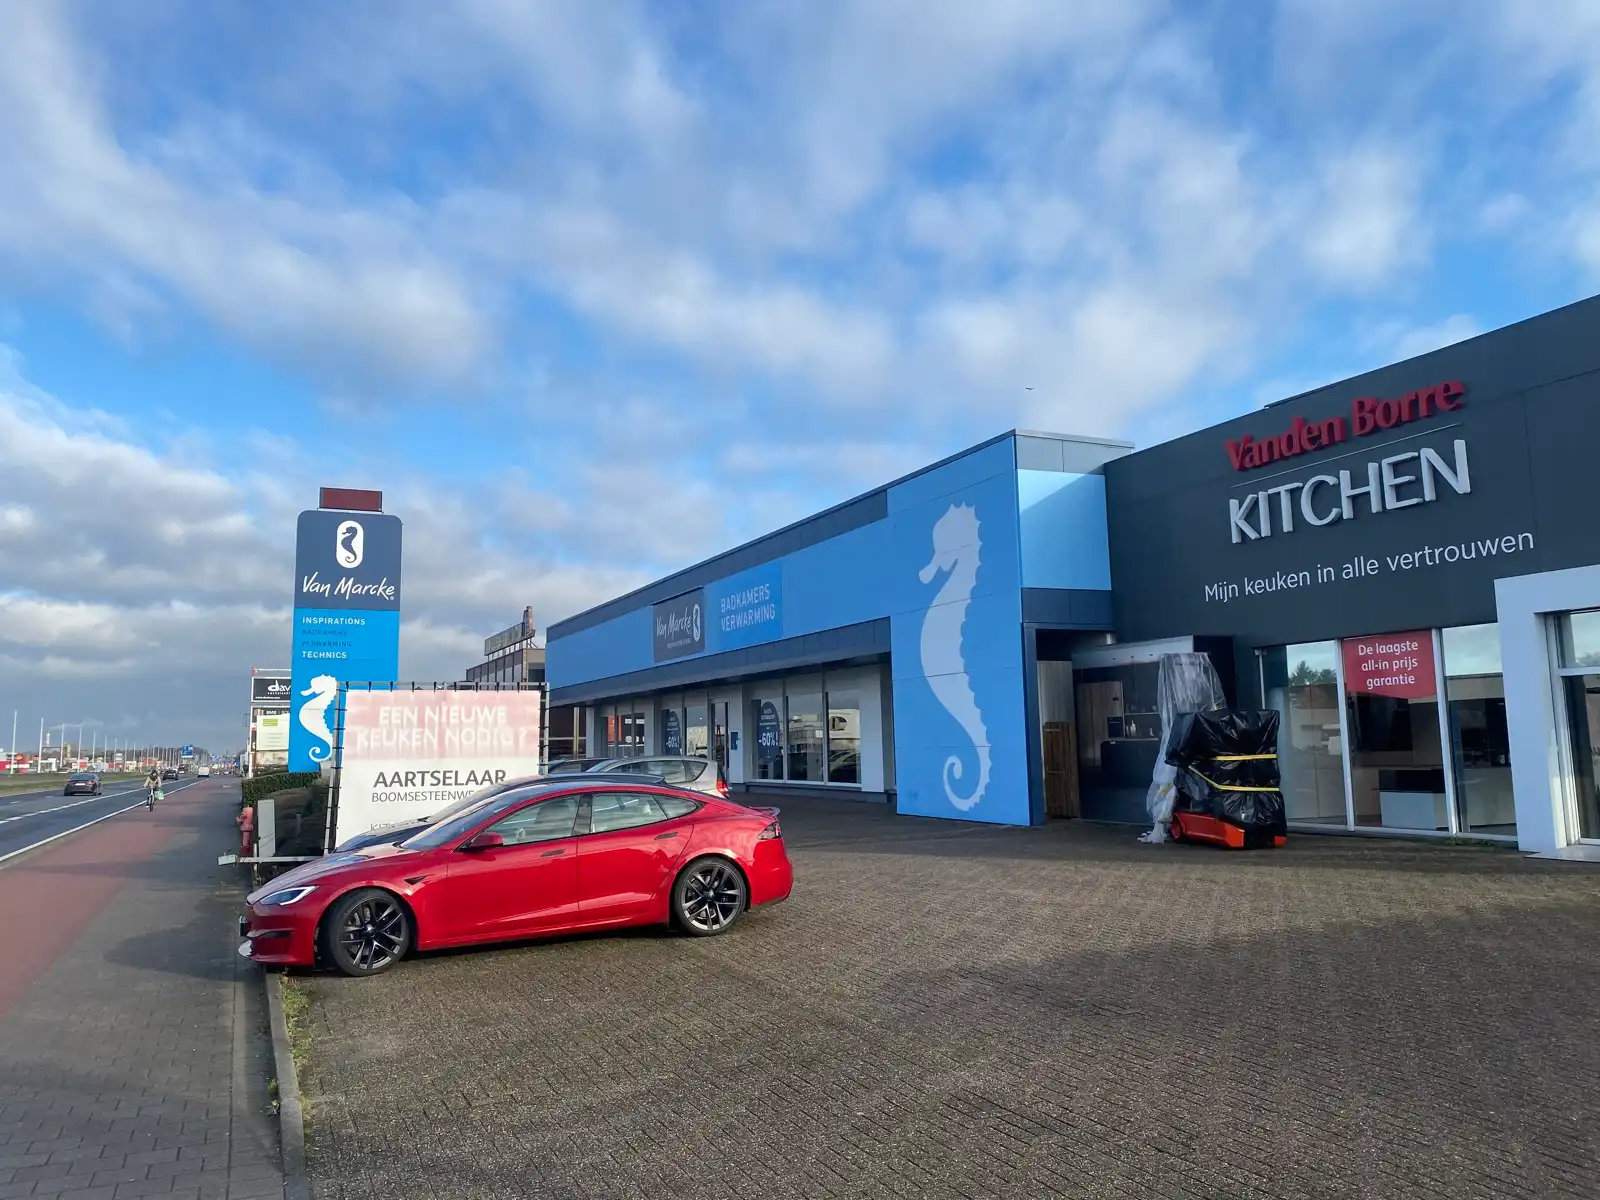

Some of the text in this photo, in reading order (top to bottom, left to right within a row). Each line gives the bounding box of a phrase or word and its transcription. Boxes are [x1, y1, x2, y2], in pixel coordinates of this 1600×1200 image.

[1225, 379, 1465, 471] Vanden Borre
[1229, 439, 1471, 544] KITCHEN
[1204, 531, 1535, 603] Mijn keuken in alle vertrouwen
[302, 571, 395, 600] Van Marcke
[720, 583, 770, 613] BADKAMERS
[302, 616, 366, 626] INSPIRATIONS
[656, 606, 692, 640] Van Marcke
[720, 603, 776, 632] VERWARMING
[301, 650, 347, 659] TECHNICS
[1357, 639, 1419, 657] De laagste
[1361, 656, 1418, 672] all-in prijs
[1366, 673, 1416, 689] garantie
[379, 703, 508, 725] EEN NIEUWE
[357, 728, 439, 750] KEUKEN
[759, 731, 778, 746] -60%!
[373, 769, 507, 788] AARTSELAAR
